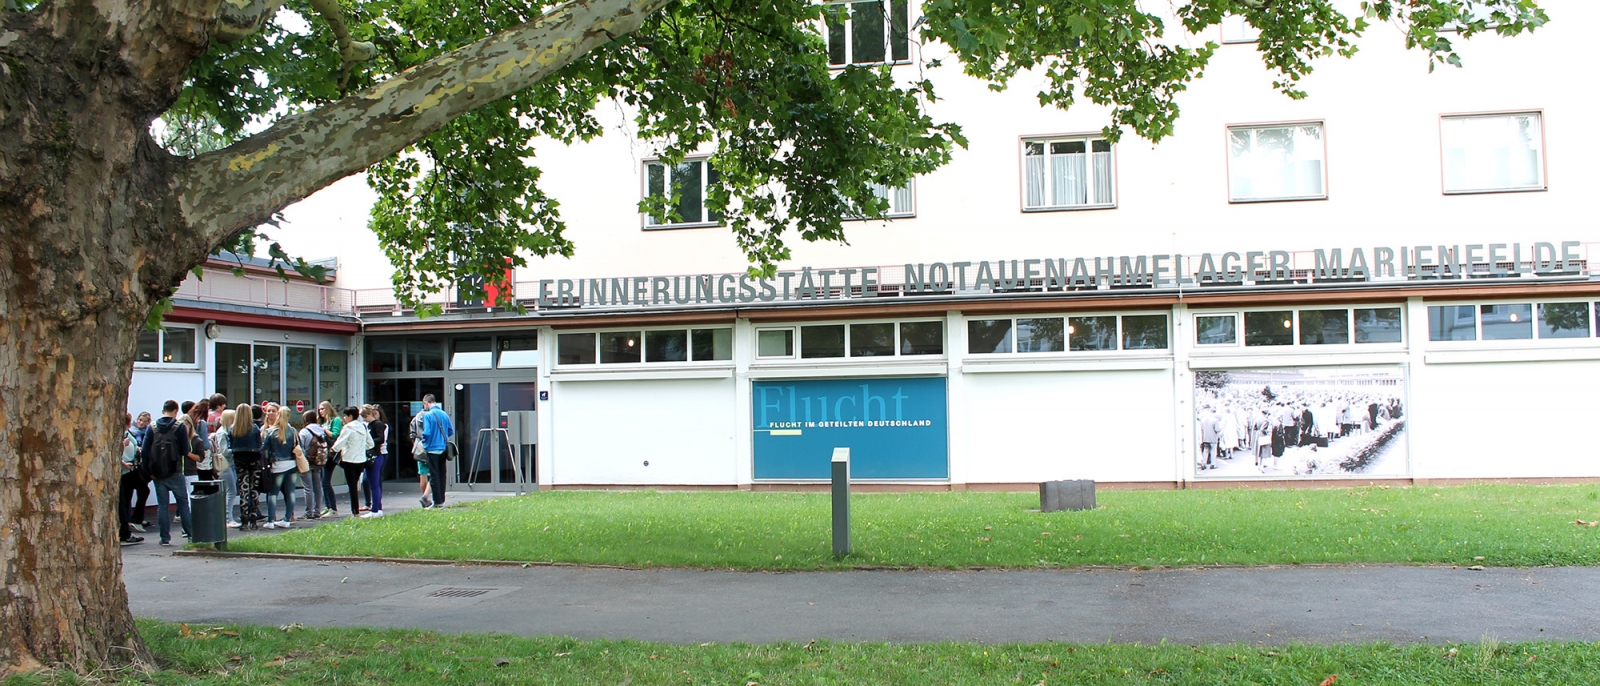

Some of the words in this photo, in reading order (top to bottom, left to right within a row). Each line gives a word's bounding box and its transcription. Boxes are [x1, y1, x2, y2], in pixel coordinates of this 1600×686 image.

[539, 266, 878, 306] ERINNERUNGSSTÄTTE
[904, 250, 1290, 292] NOTAUFNAHMELAGER
[1314, 241, 1580, 279] MARIENFELDE
[756, 384, 908, 428] Flucht
[818, 420, 864, 428] GETEILTEN
